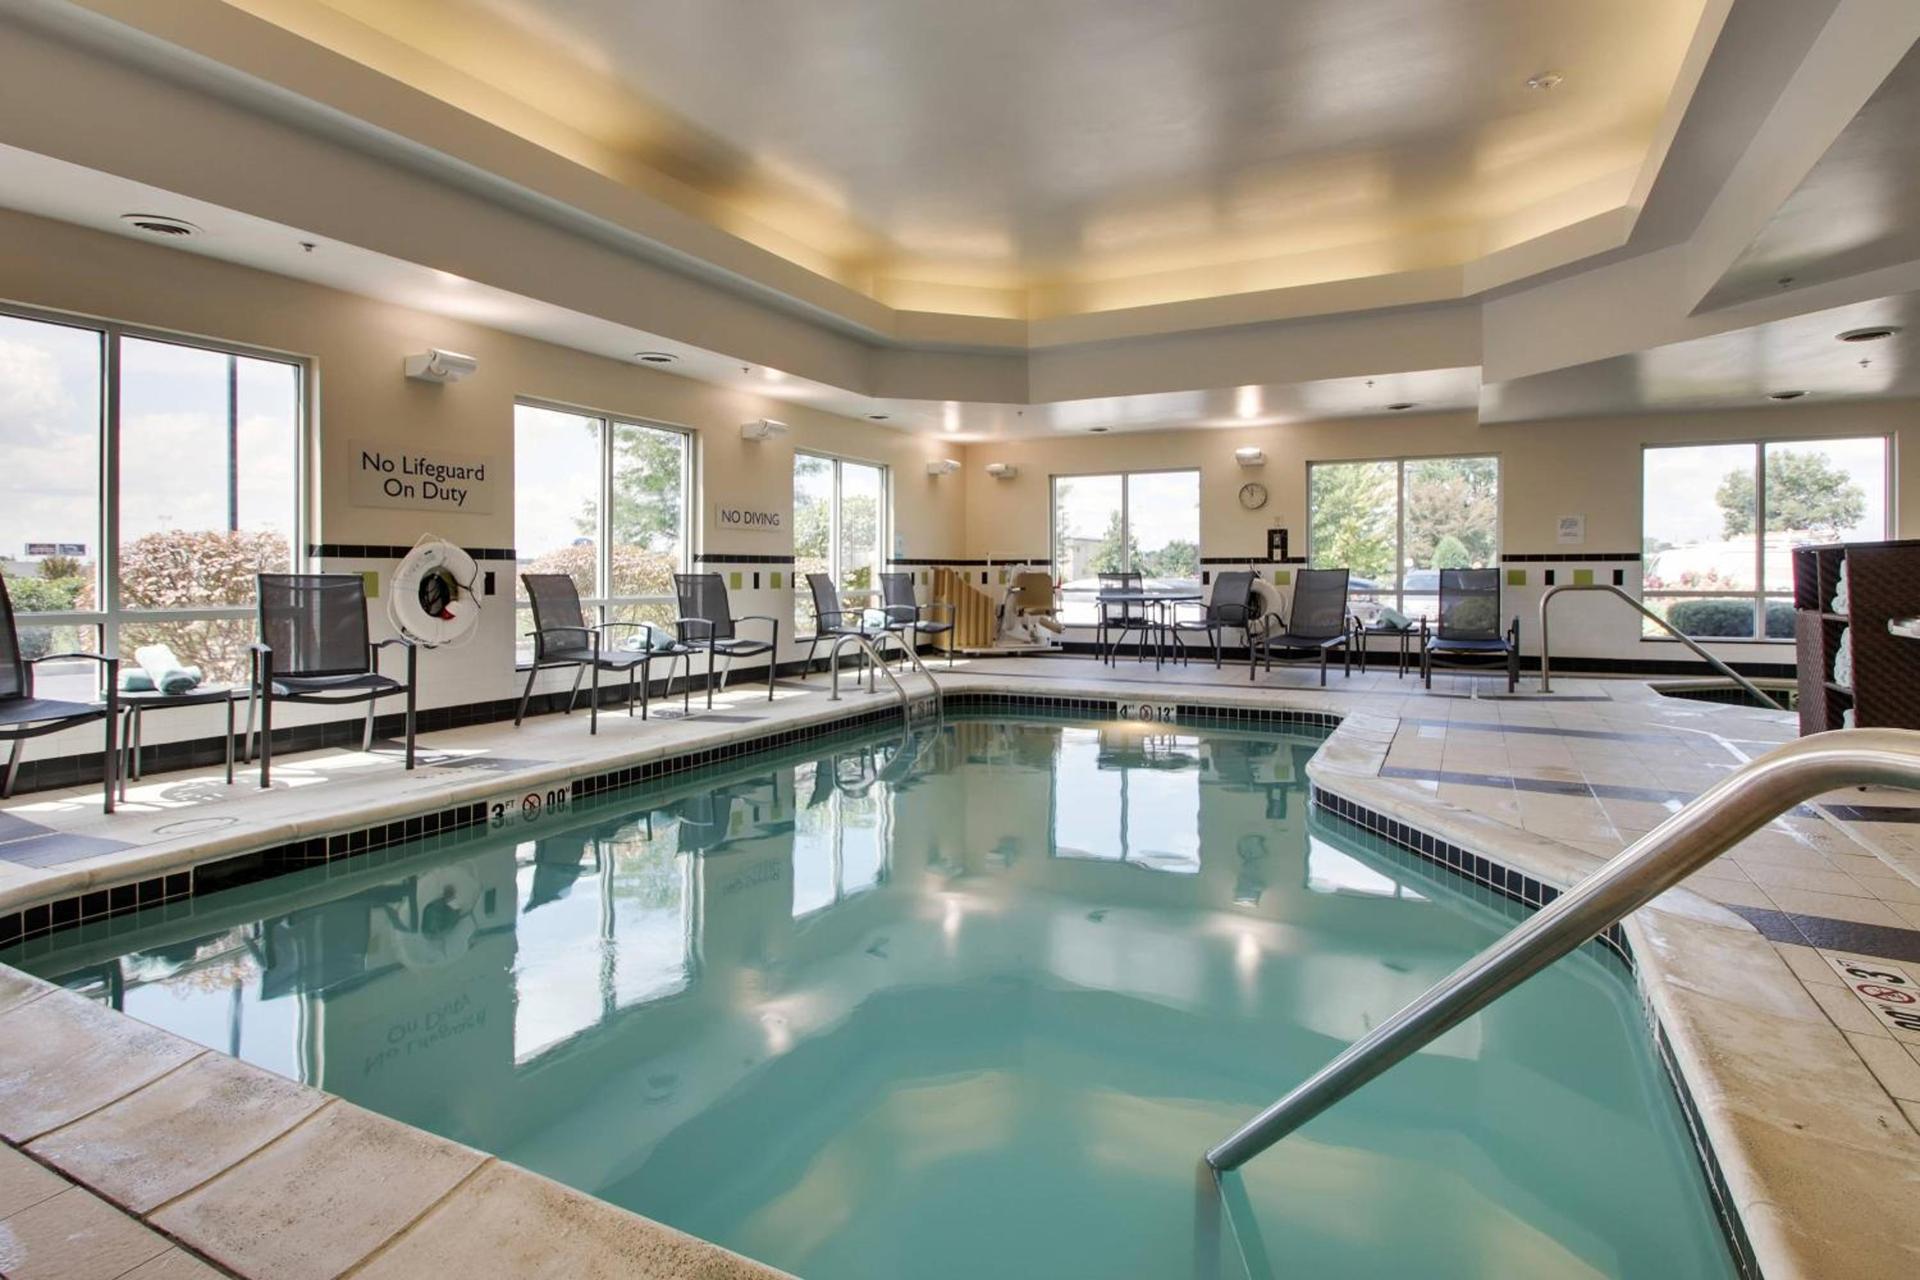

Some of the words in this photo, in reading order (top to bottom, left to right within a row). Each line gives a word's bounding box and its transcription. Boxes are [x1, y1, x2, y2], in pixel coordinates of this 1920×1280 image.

[362, 451, 395, 473] No
[403, 456, 485, 482] Lifeguard
[383, 478, 414, 498] On
[423, 481, 467, 506] Duty
[721, 509, 740, 523] NO
[744, 511, 780, 526] DIVING
